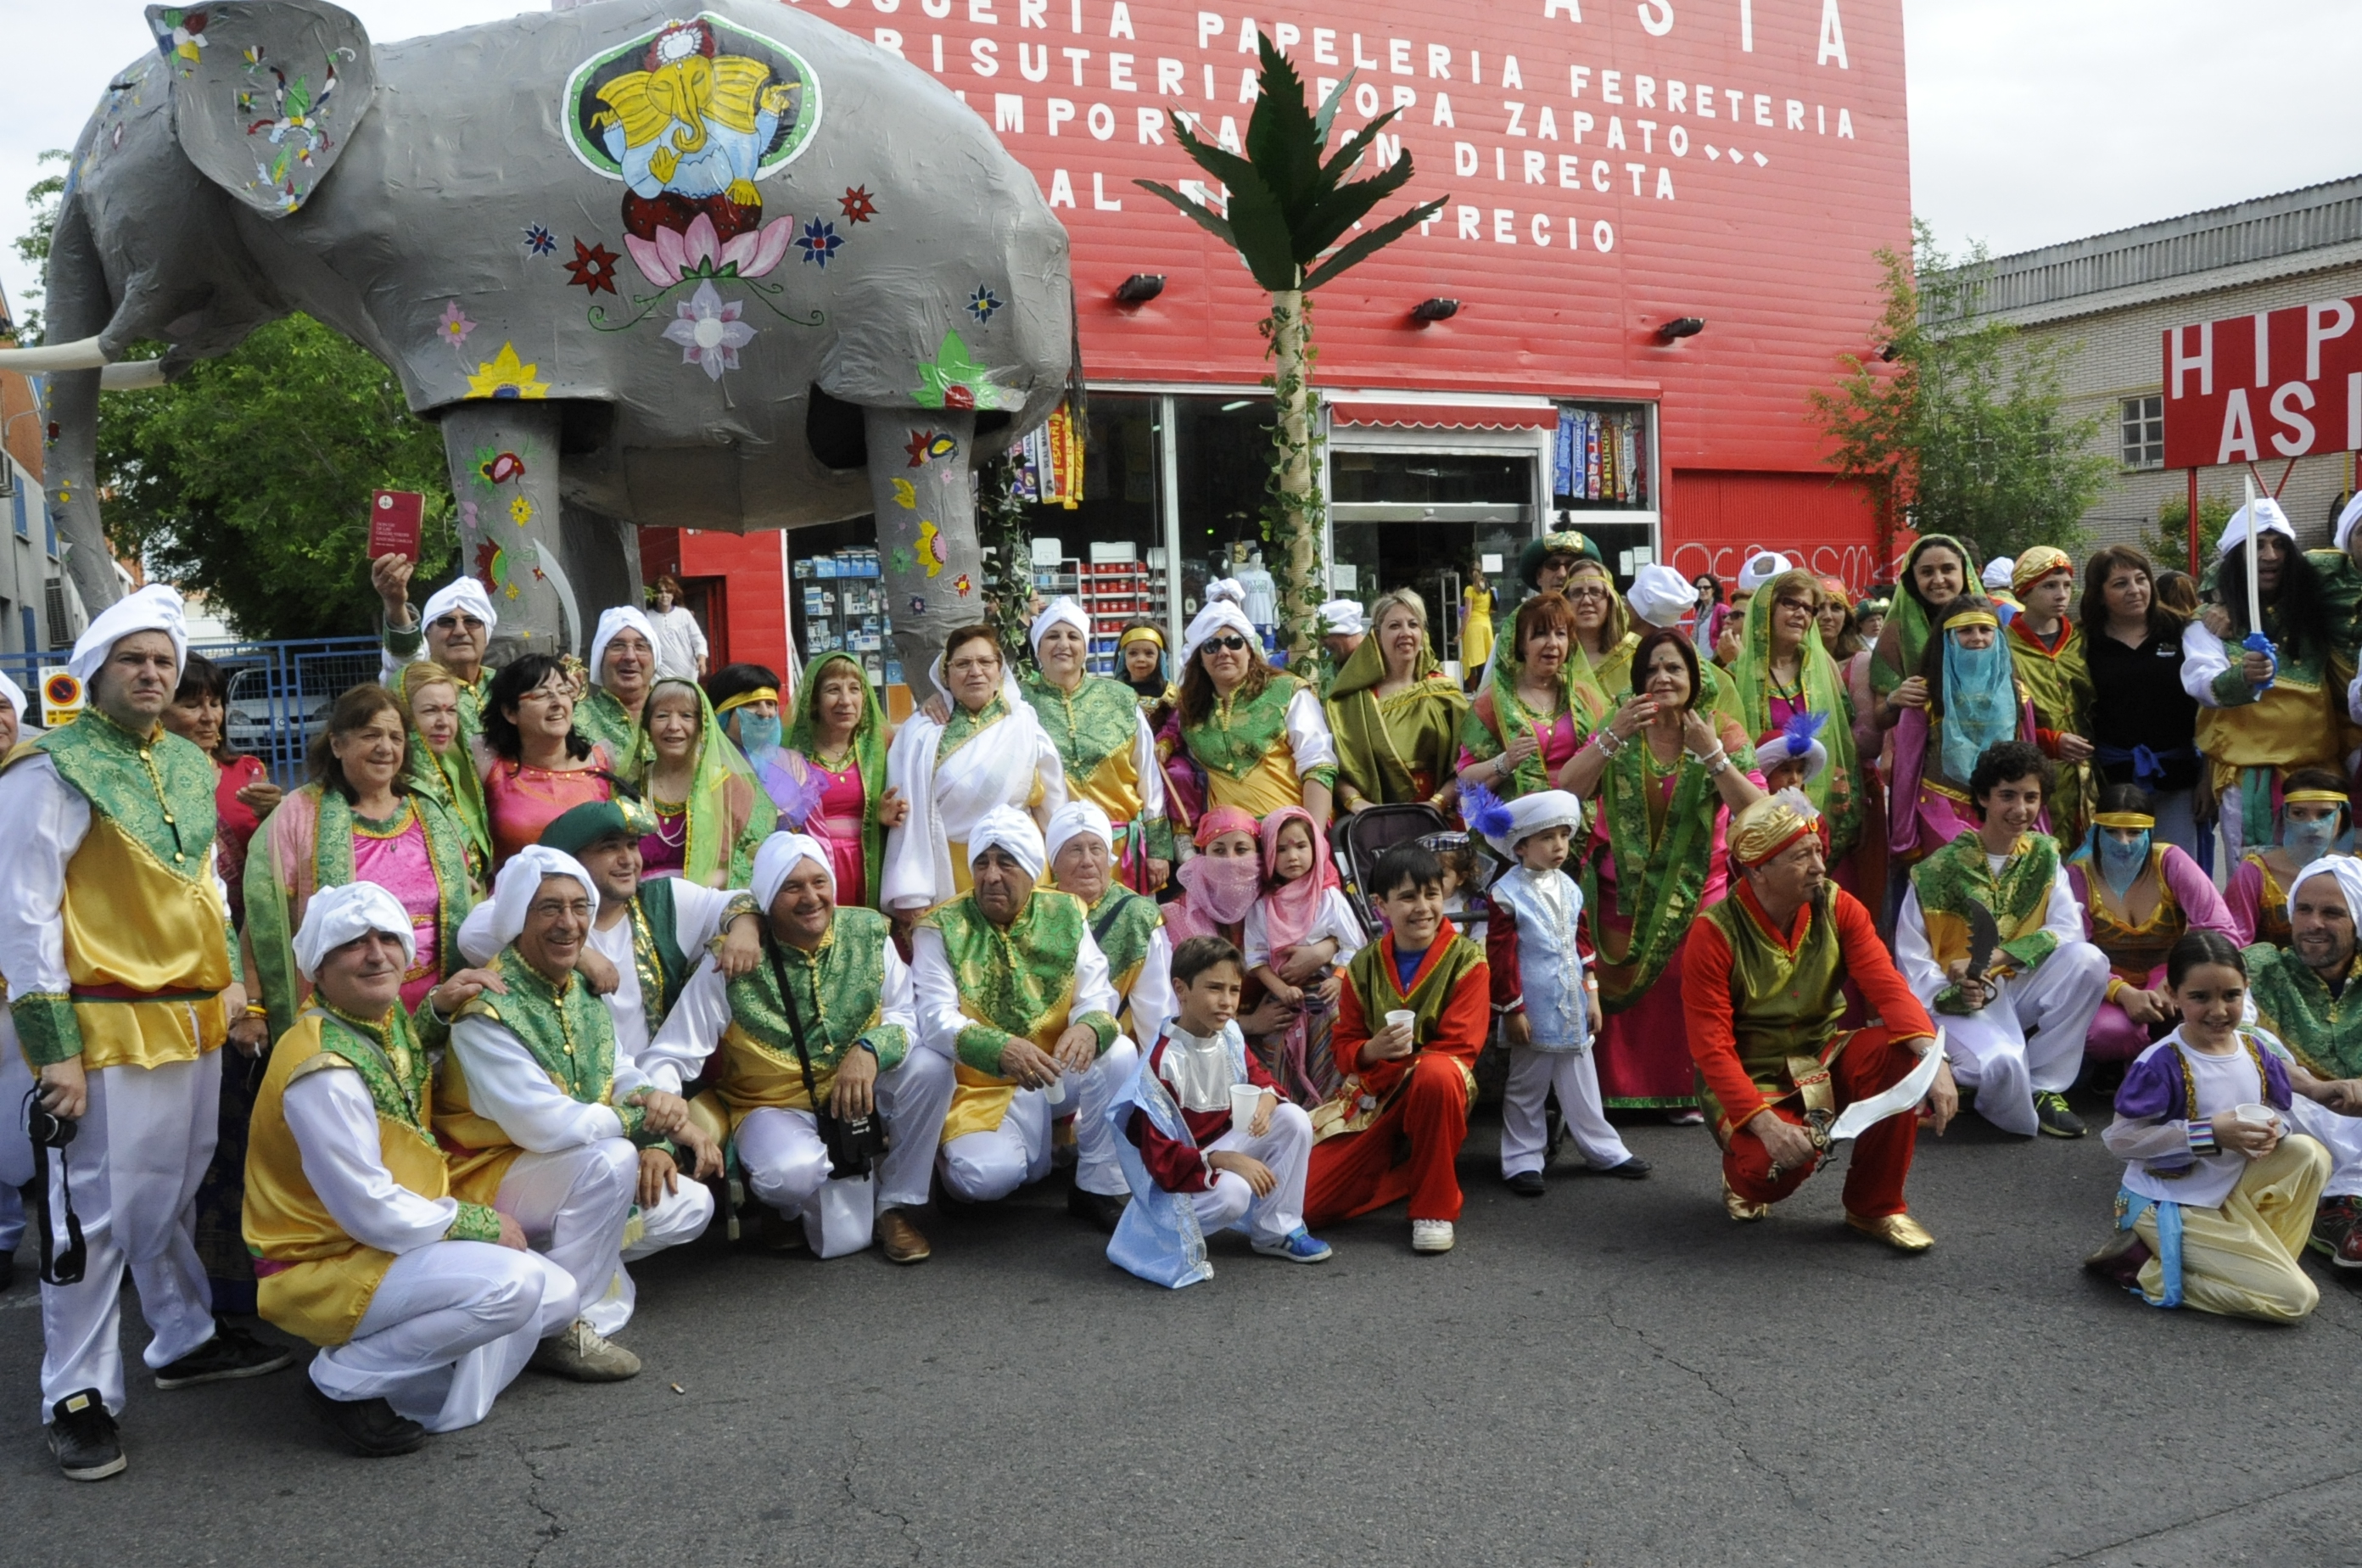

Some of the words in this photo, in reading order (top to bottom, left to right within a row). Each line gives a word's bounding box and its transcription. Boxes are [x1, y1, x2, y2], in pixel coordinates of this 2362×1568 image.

[875, 28, 1261, 104] BISUTERIA
[1198, 11, 1524, 90] PAPELERIA
[1570, 64, 1855, 140] FERRETERIA
[1454, 142, 1676, 200] DIRECTA
[1419, 201, 1614, 254] PRECIO
